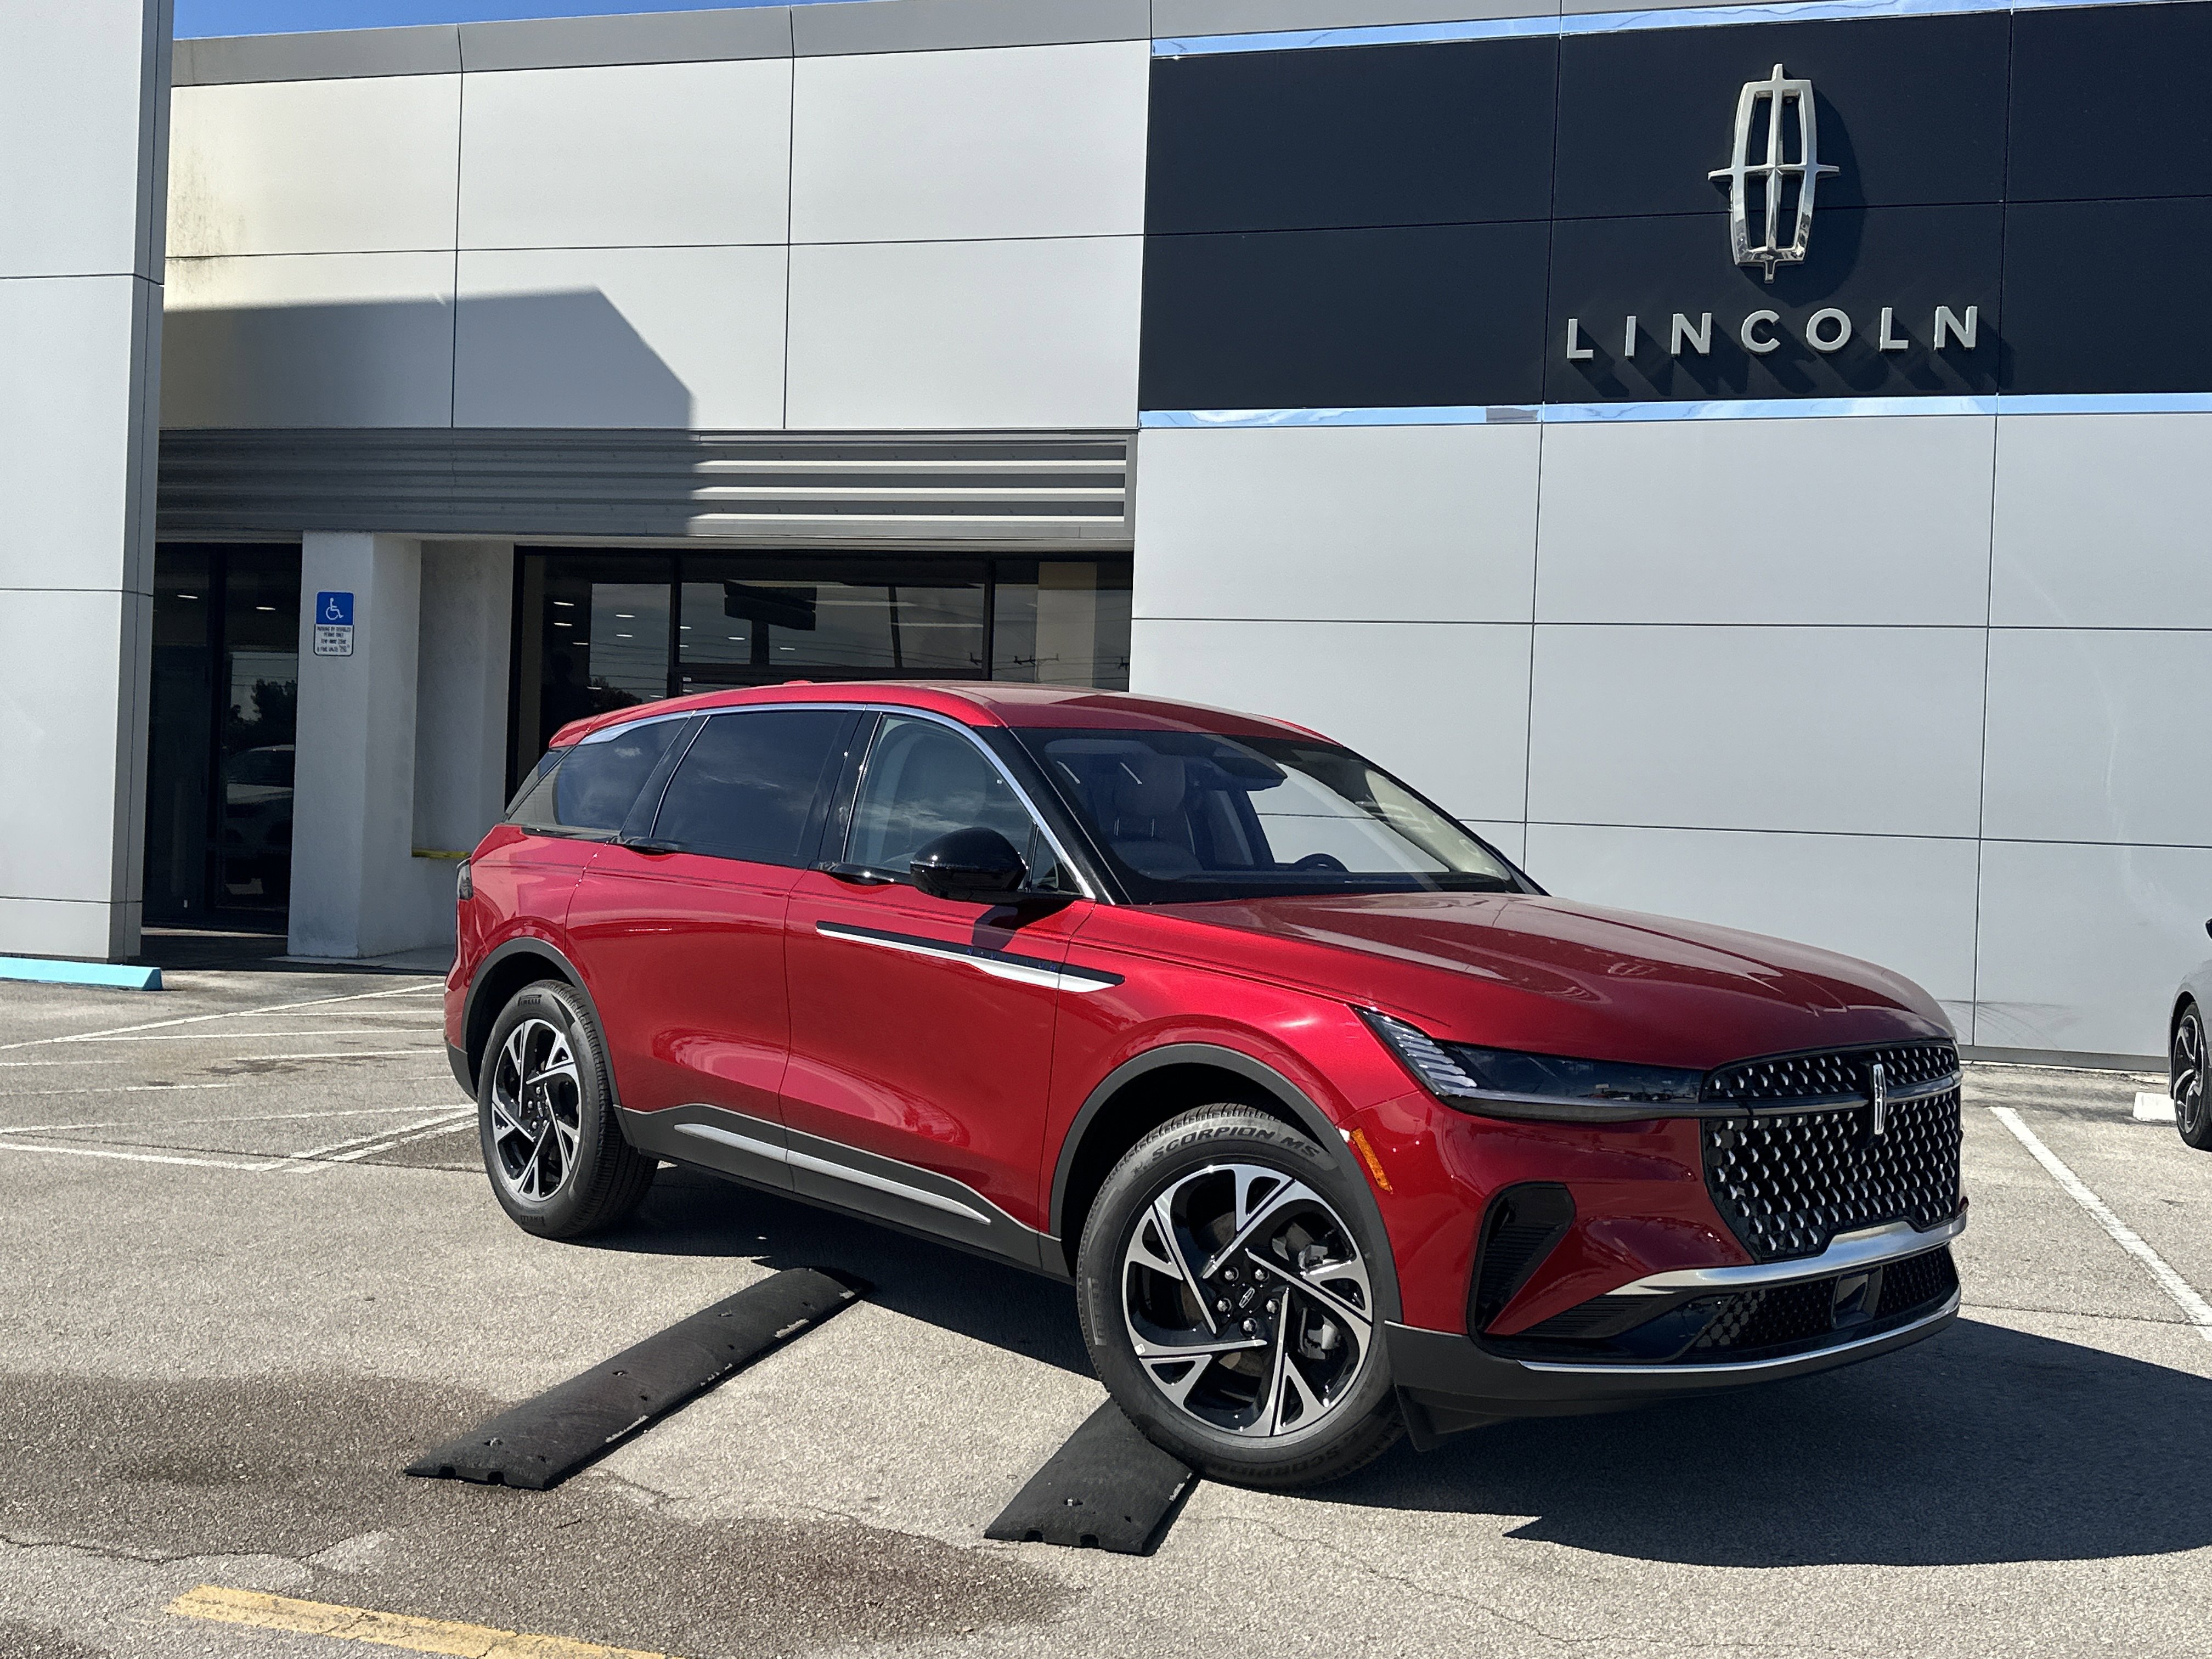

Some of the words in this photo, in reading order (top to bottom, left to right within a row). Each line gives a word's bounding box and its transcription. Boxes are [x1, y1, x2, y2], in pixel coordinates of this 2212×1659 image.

[1567, 306, 1978, 359] LINCOLN
[1152, 1126, 1276, 1161] SCORPION
[1280, 1137, 1321, 1158] MS
